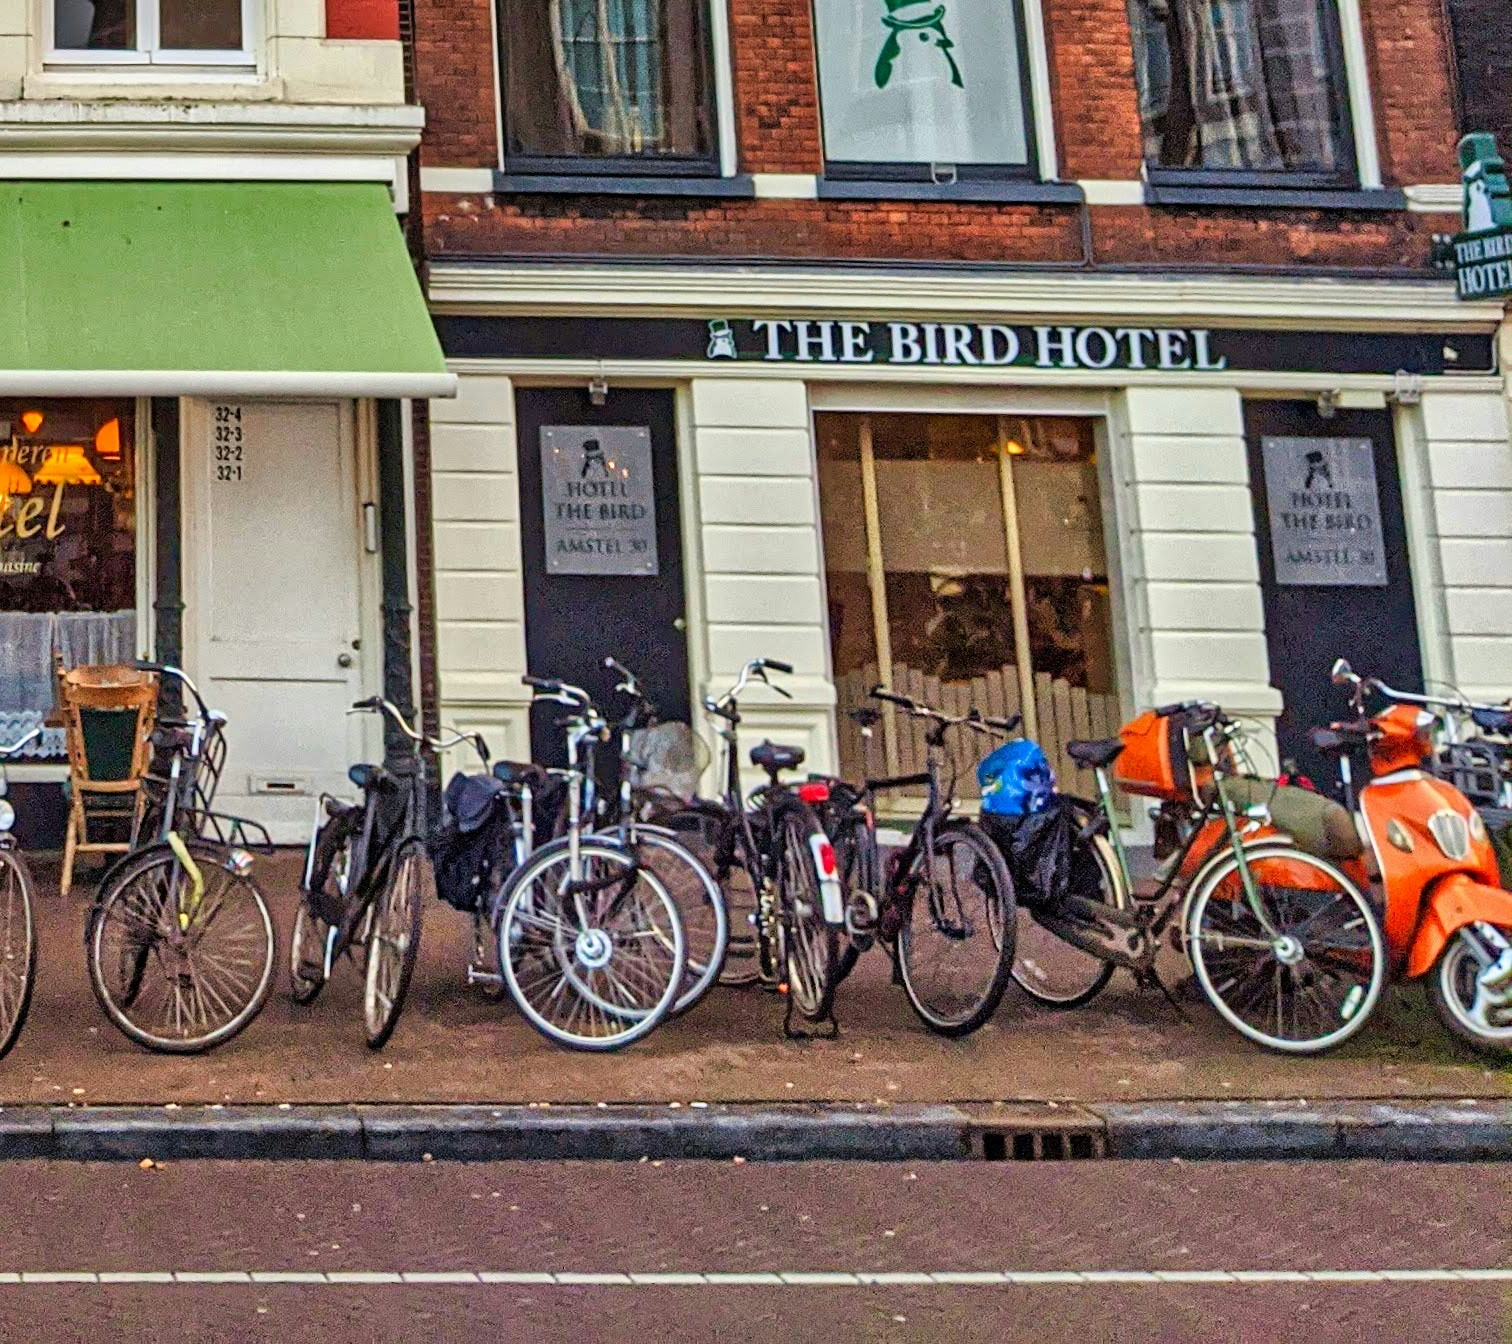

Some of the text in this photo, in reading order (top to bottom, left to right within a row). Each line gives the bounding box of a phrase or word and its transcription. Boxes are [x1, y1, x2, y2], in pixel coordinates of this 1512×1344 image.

[1454, 239, 1483, 264] THE
[753, 320, 1226, 370] THE BIRD HOTEL
[215, 406, 242, 422] 32-4
[215, 426, 242, 441] 32-3
[215, 446, 243, 461] 32-2
[217, 465, 242, 481] 32-1
[555, 502, 647, 520] THE BIRD
